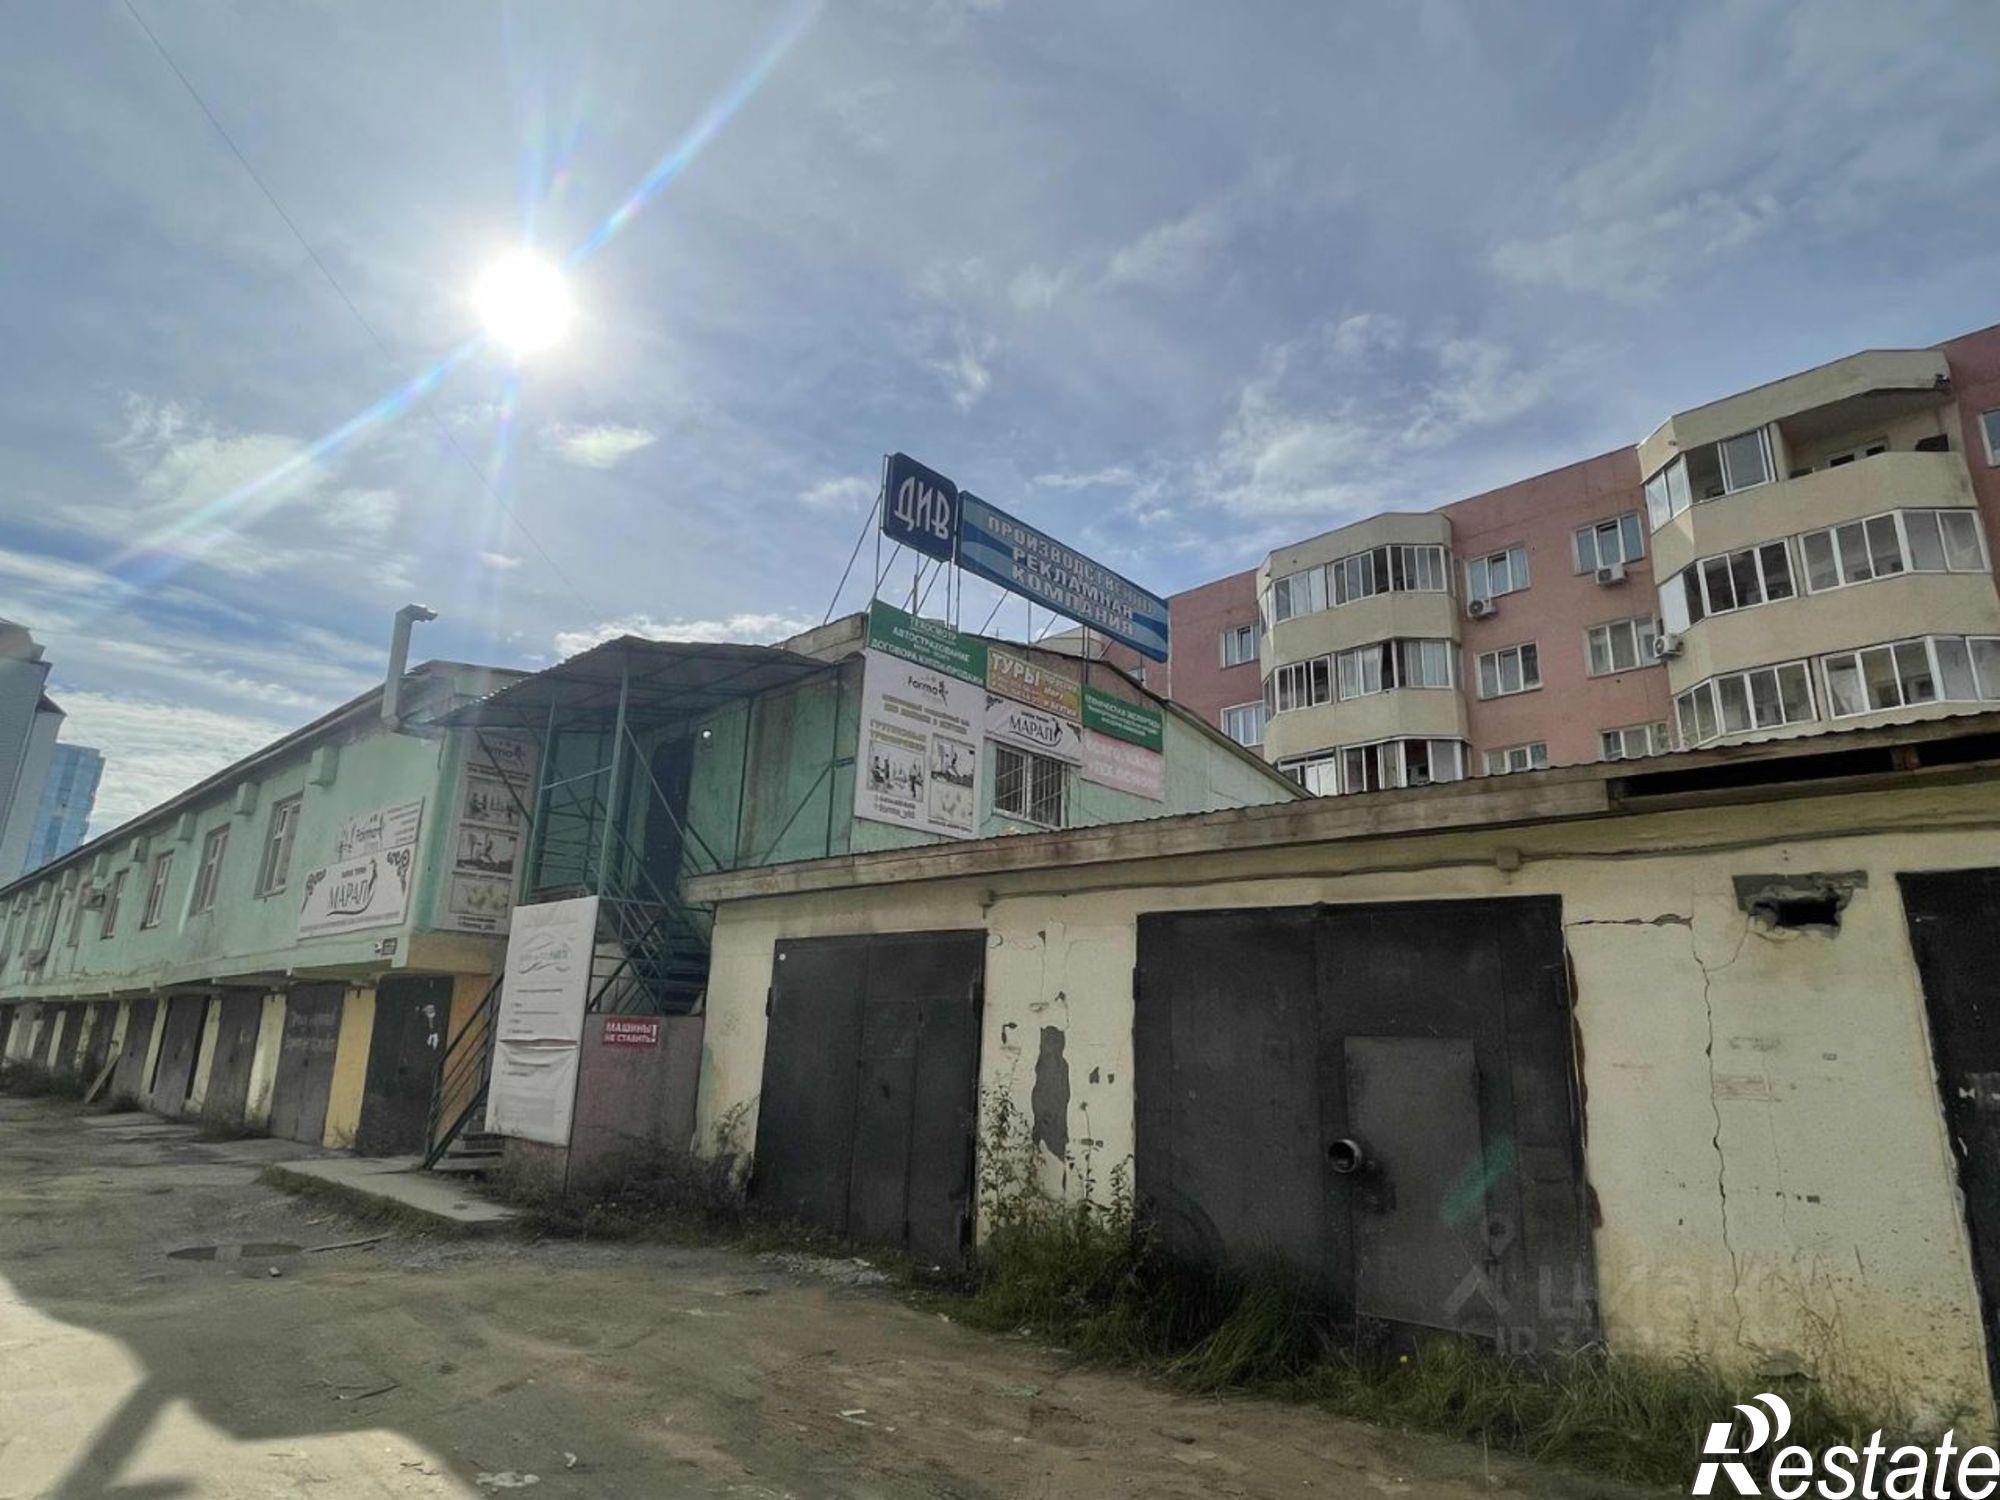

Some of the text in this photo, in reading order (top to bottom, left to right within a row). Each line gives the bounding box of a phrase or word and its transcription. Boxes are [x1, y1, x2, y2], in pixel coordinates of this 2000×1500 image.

[894, 476, 950, 540] ДИВ
[1011, 565, 1134, 636] КОМПАНИЯ
[1012, 547, 1134, 619] РЕКЛАМНАЯ
[991, 652, 1040, 686] ТУРЫ
[1009, 714, 1054, 742] МАРАЛ
